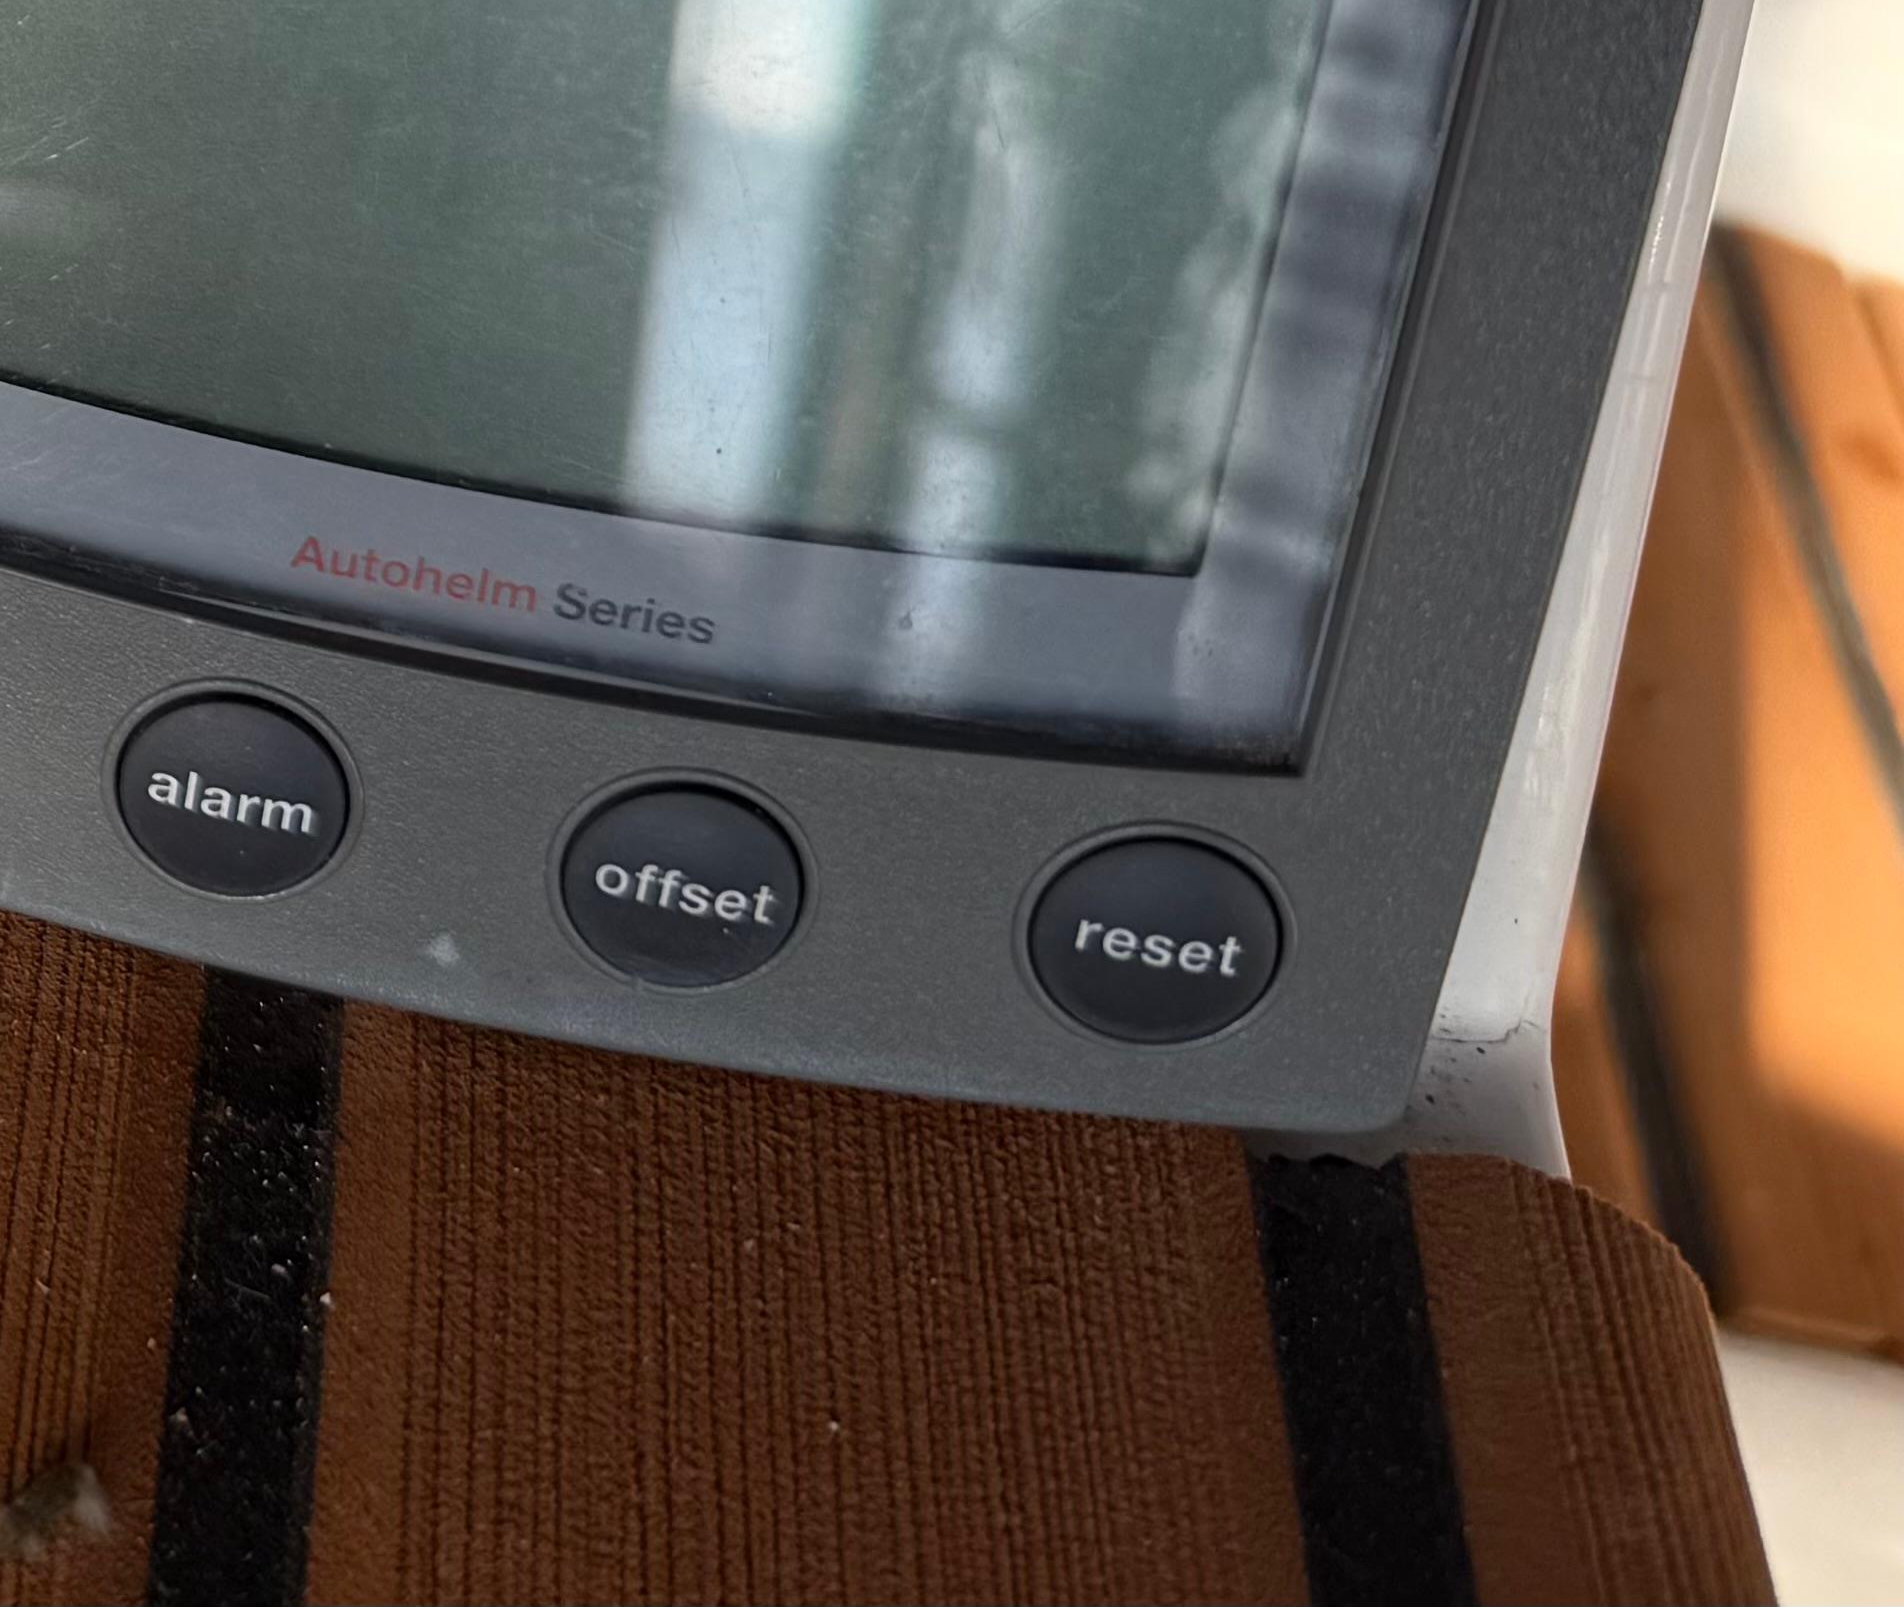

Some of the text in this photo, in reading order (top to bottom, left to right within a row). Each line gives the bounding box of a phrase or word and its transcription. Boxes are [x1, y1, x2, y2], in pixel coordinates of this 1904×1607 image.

[292, 535, 716, 645] Autohelm Series
[147, 770, 314, 834] alarm
[595, 862, 774, 926] offset
[1074, 917, 1242, 977] reset
